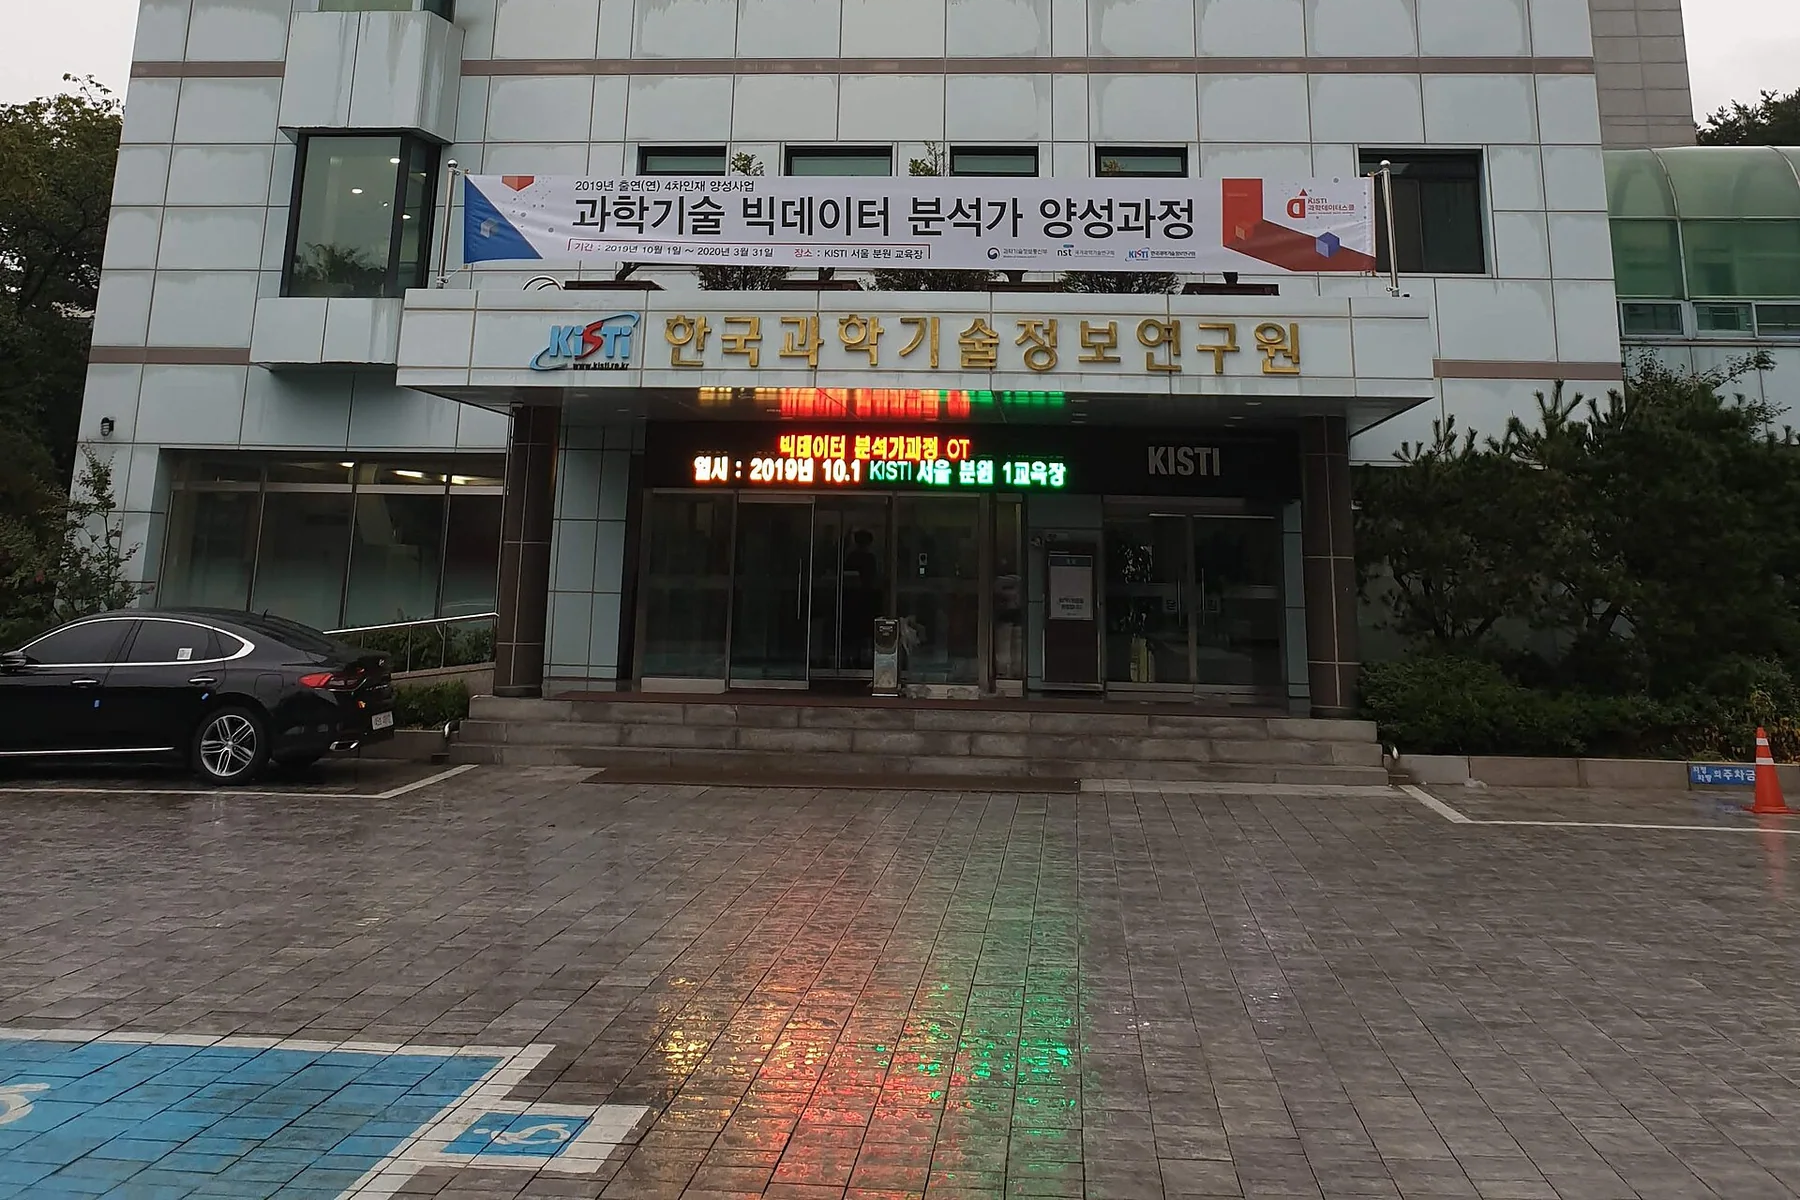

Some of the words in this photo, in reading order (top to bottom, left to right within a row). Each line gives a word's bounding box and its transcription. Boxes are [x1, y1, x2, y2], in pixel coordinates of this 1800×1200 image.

[575, 180, 614, 192] 2019년
[618, 180, 661, 193] 출연(연)
[664, 180, 706, 193] 4차인재
[709, 180, 755, 193] 양성사업
[572, 195, 726, 236] 과학기술
[742, 196, 890, 237] 빅데이터
[907, 196, 1024, 239] 분석가
[1039, 197, 1195, 240] 양성과정
[574, 242, 594, 253] 기간
[604, 244, 638, 254] 2019년
[642, 245, 663, 255] 10월
[667, 246, 682, 256] 1일
[697, 247, 730, 257] 2020년
[733, 248, 749, 257] 3월
[752, 248, 774, 258] 31일
[794, 248, 813, 259] 장소
[824, 249, 848, 258] KISTI
[851, 249, 870, 259] 서울
[872, 249, 892, 259] 분원
[895, 249, 924, 260] 교육장
[1057, 248, 1073, 257] nst
[665, 314, 1301, 374] 한국과학기술정보연구원
[947, 438, 970, 459] OT
[749, 457, 814, 482] 2019년
[822, 458, 861, 482] 10.1
[869, 460, 912, 480] KISTI
[916, 459, 952, 484] 서울
[959, 459, 994, 484] 분원
[1002, 460, 1067, 486] 1교육장
[1148, 446, 1220, 476] KISTI
